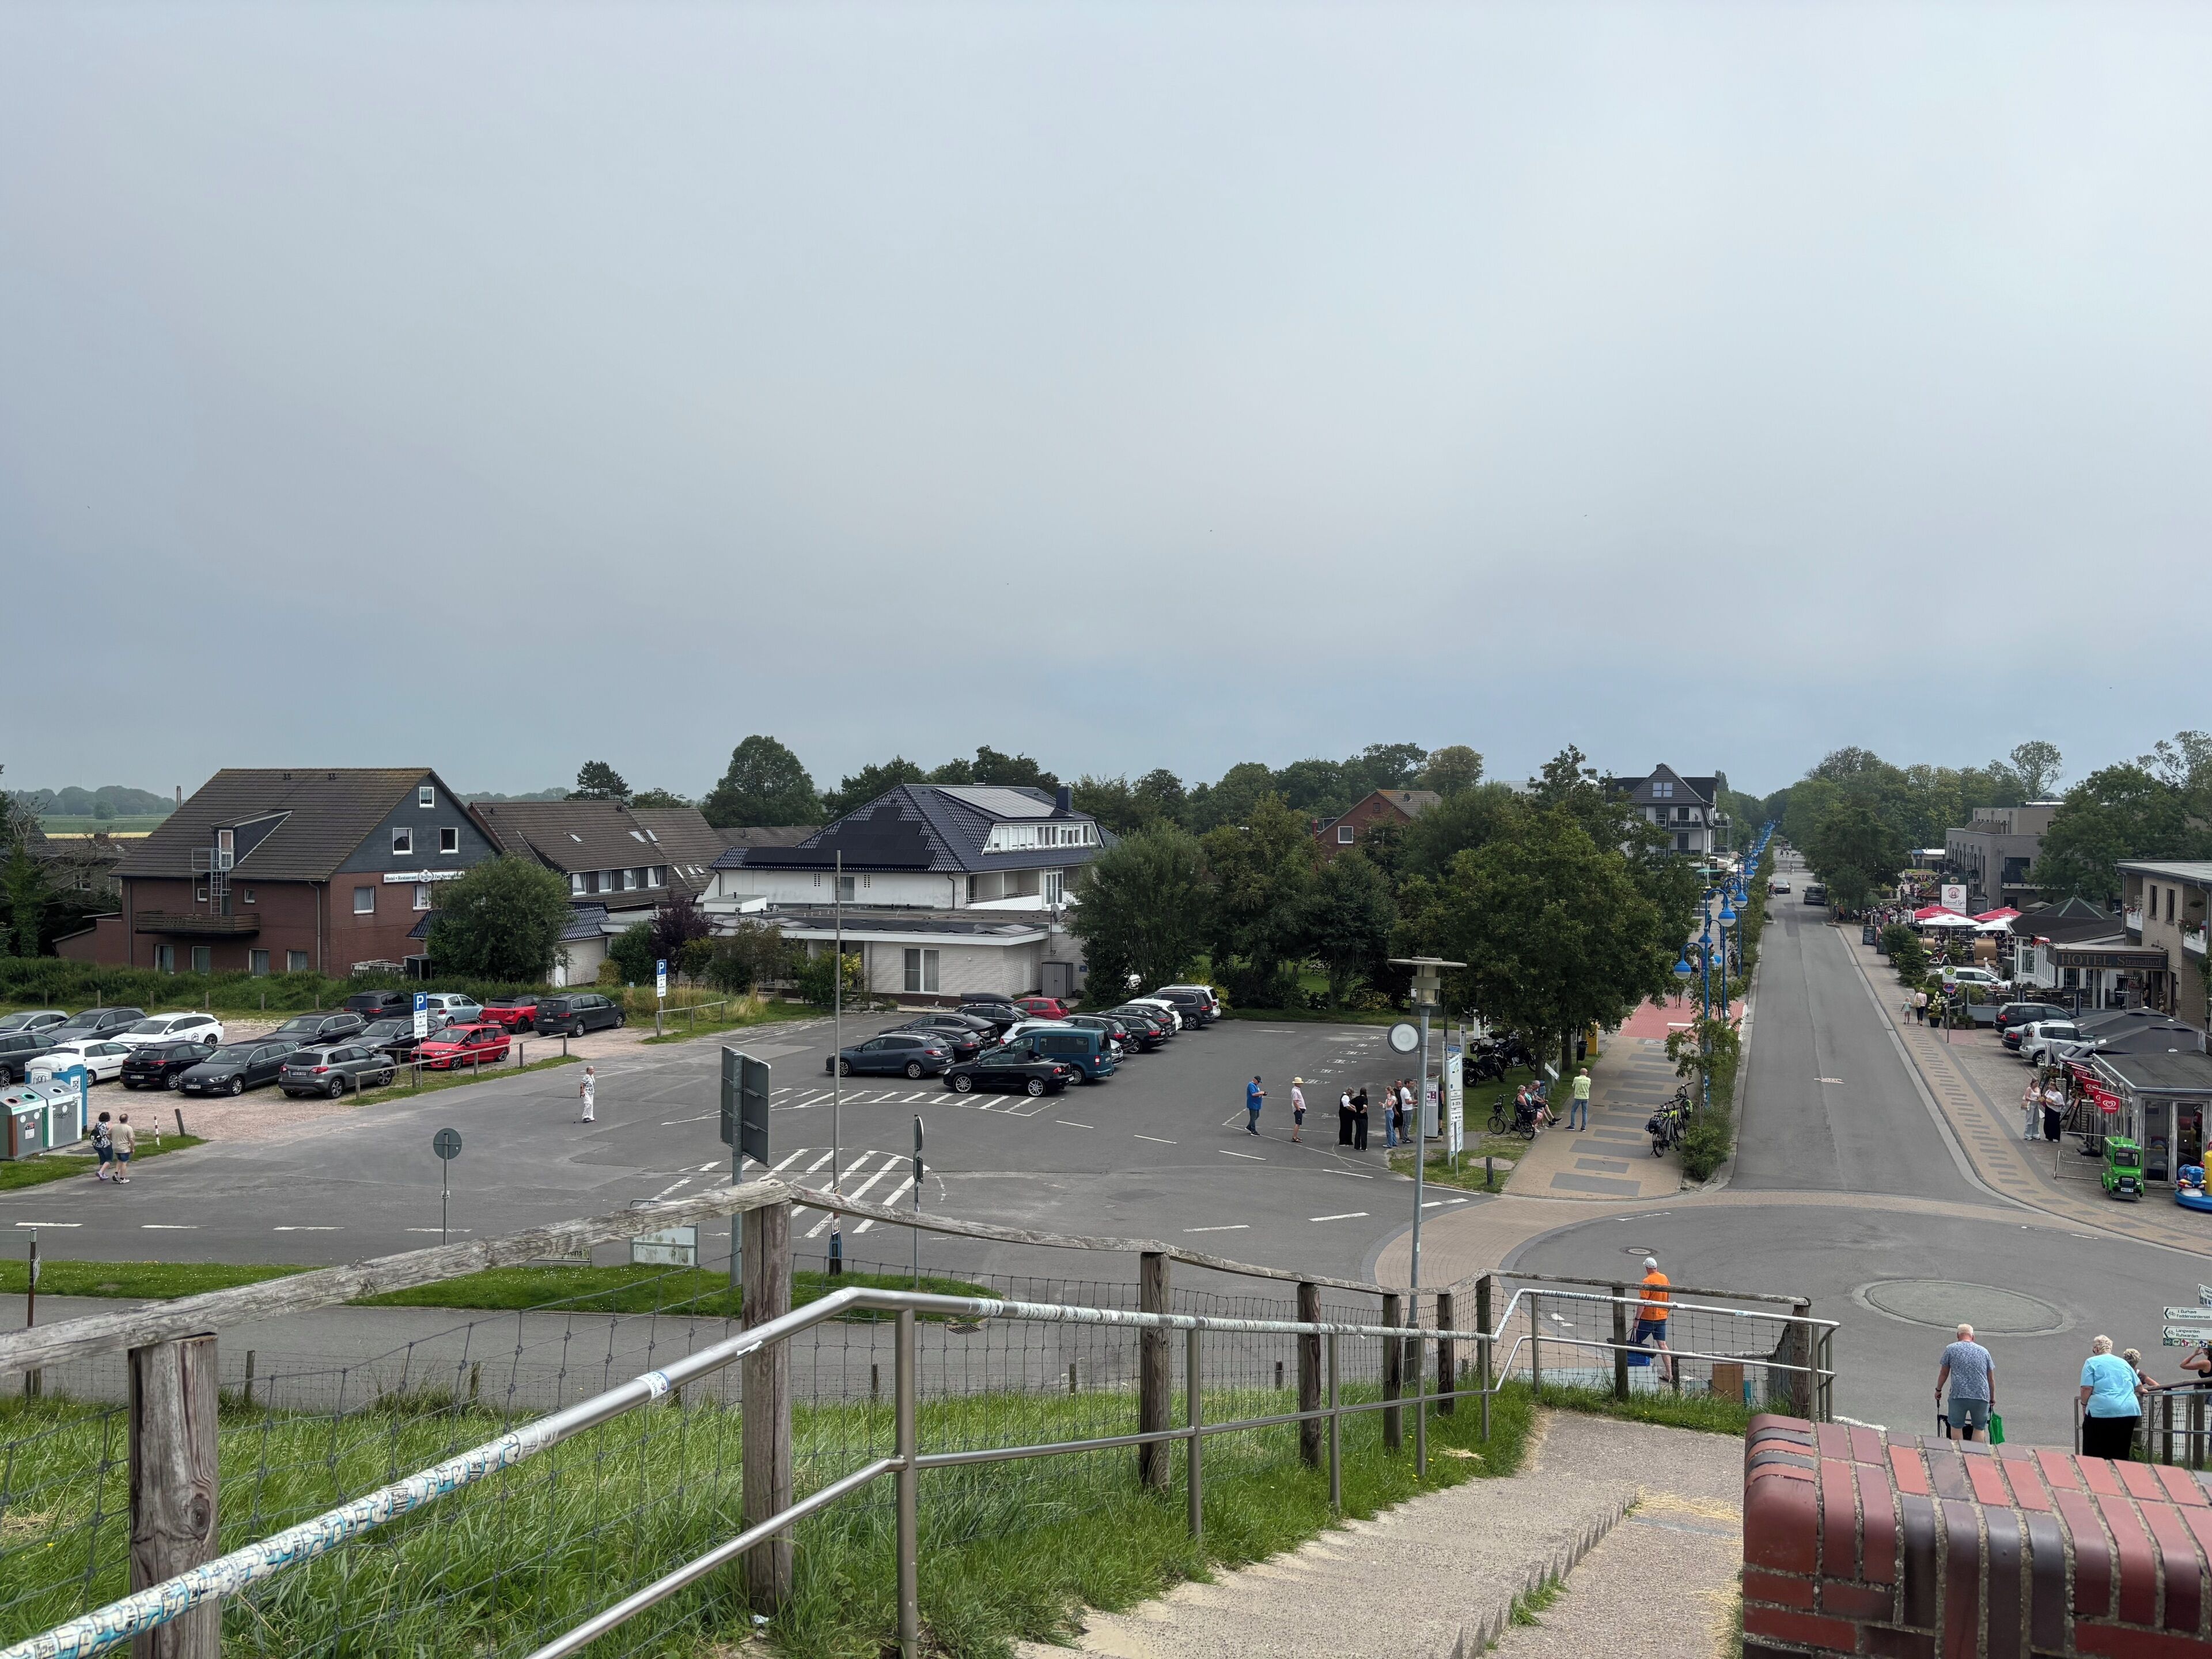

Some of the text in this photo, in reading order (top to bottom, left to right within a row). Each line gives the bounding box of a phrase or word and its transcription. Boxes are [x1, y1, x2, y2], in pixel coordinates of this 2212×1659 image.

[2061, 954, 2161, 966] HOTEL Strandhof
[658, 962, 664, 974] P
[416, 995, 424, 1009] P
